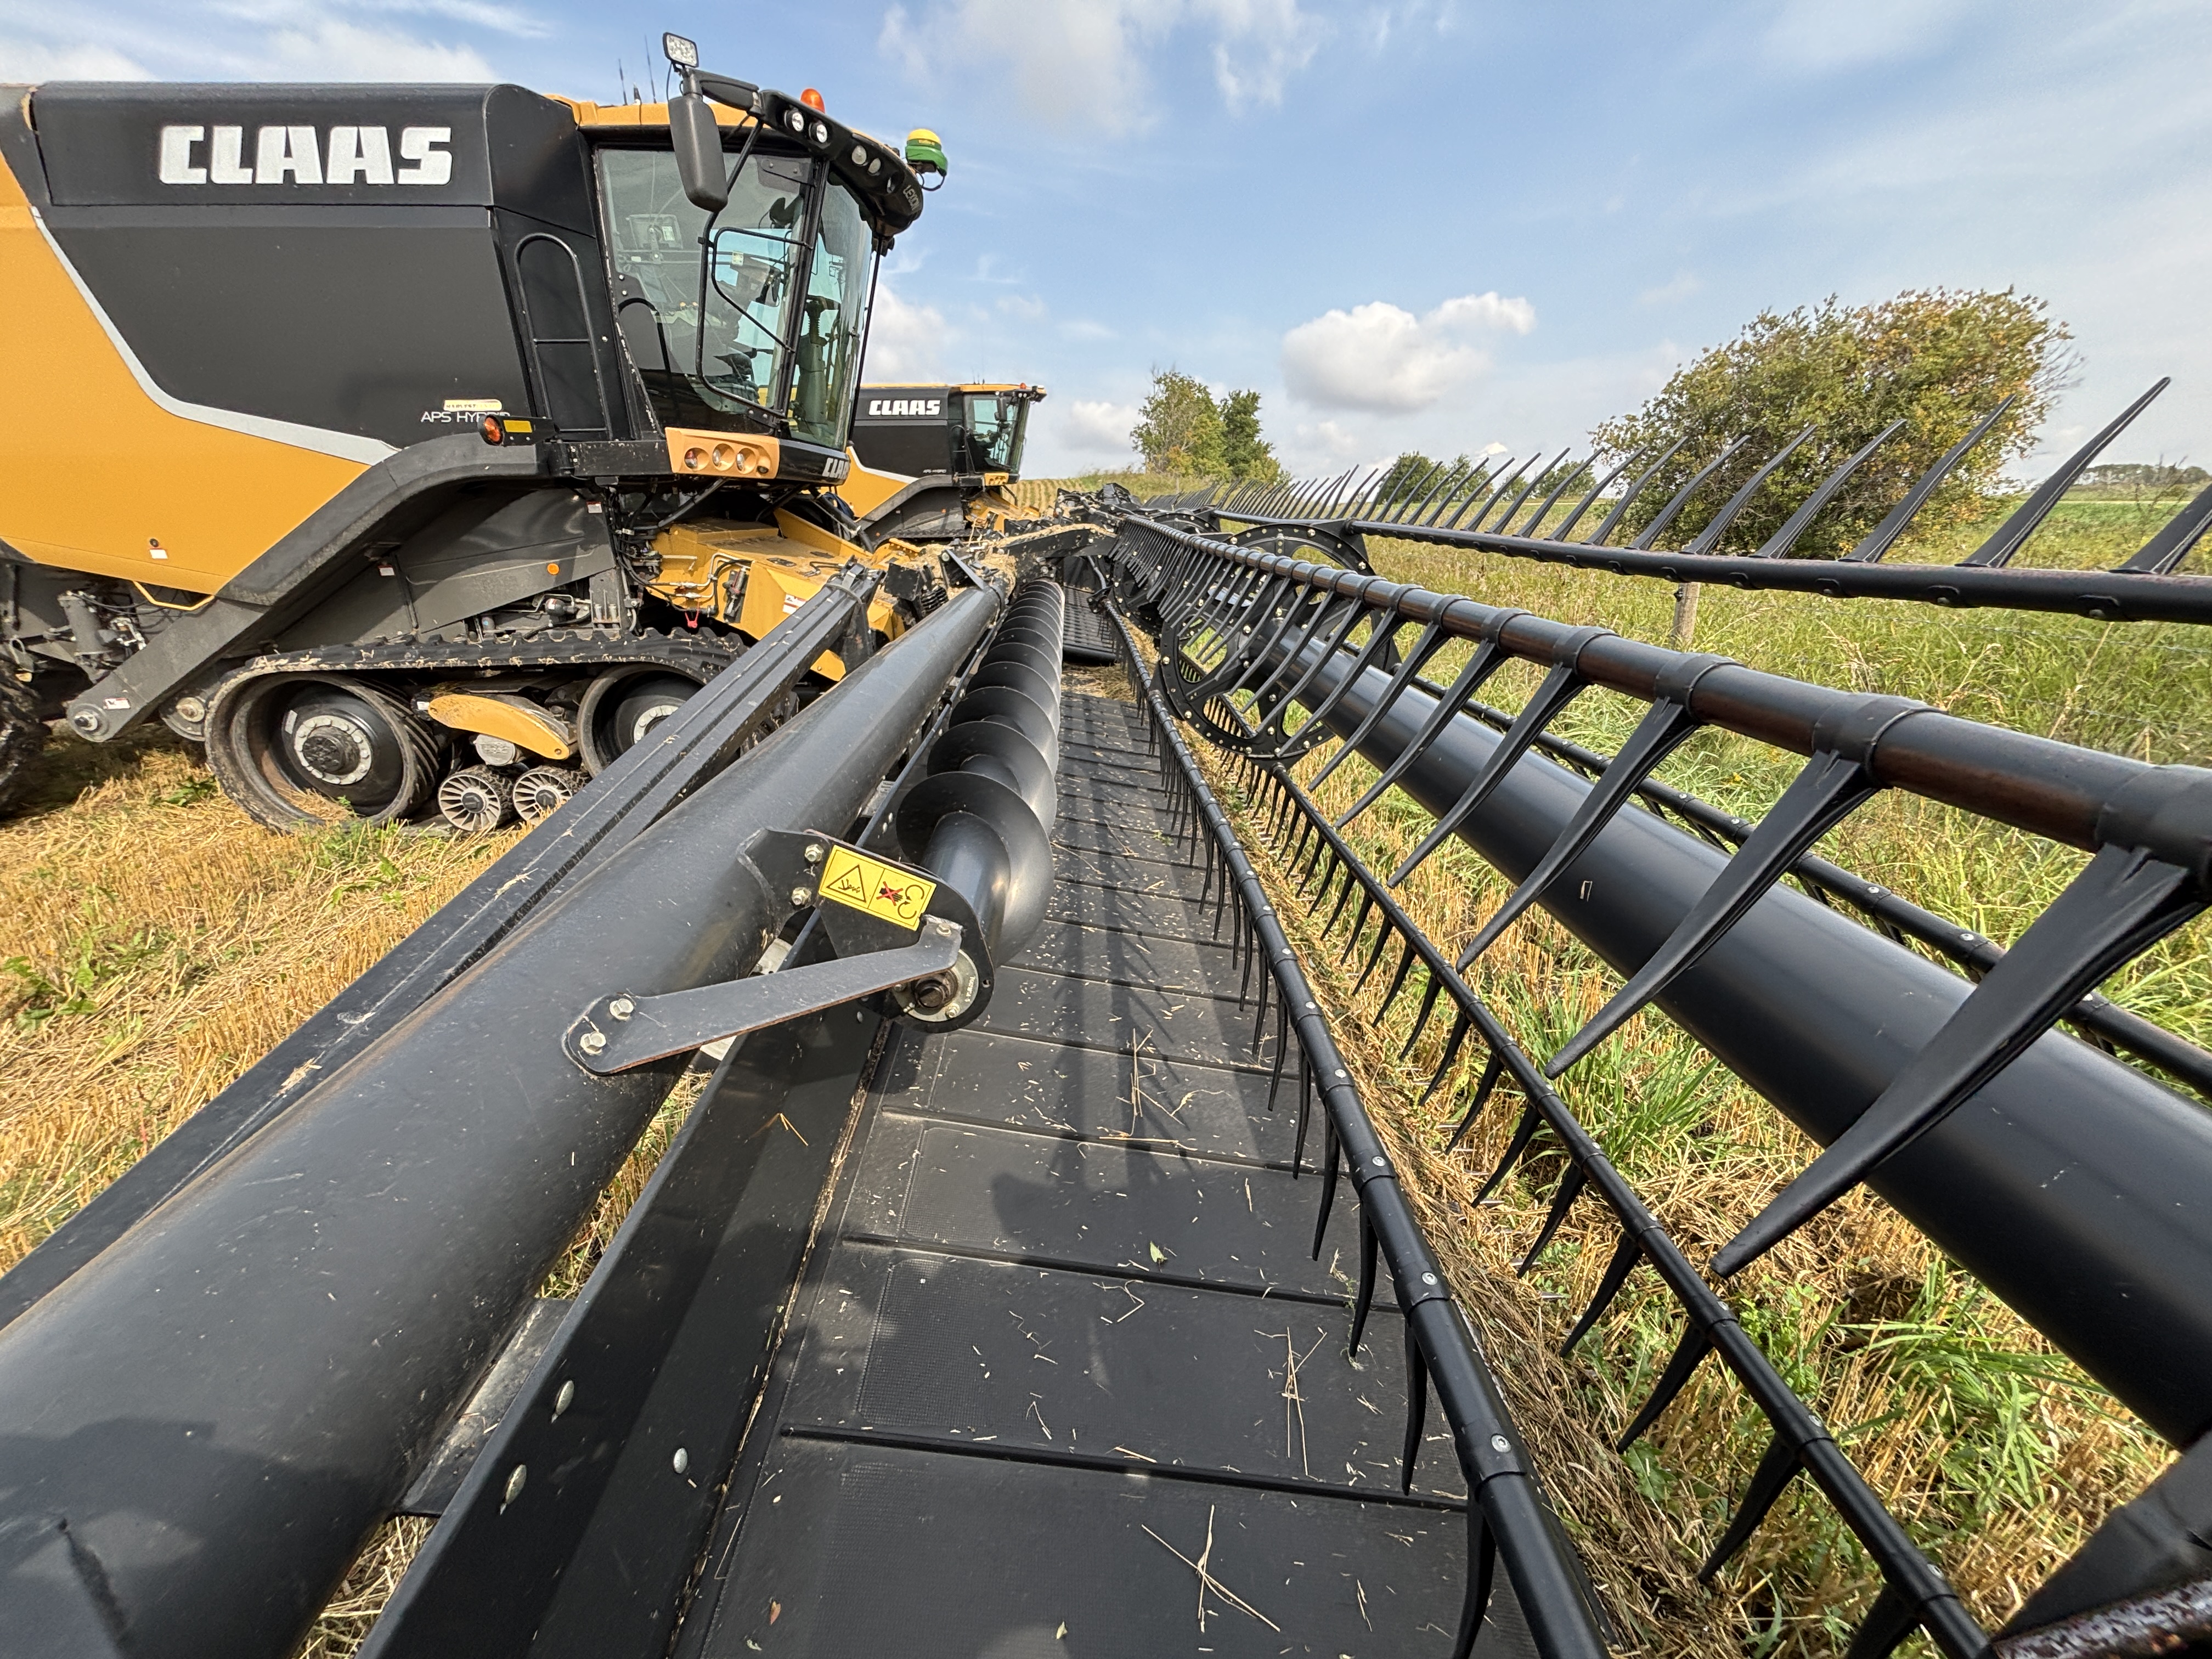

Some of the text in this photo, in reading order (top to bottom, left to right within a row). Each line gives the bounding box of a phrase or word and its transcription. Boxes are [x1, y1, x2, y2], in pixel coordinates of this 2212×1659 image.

[159, 126, 453, 185] CLAAS
[420, 411, 452, 423] APS
[868, 399, 941, 416] CLAAS
[822, 458, 850, 480] CLAA
